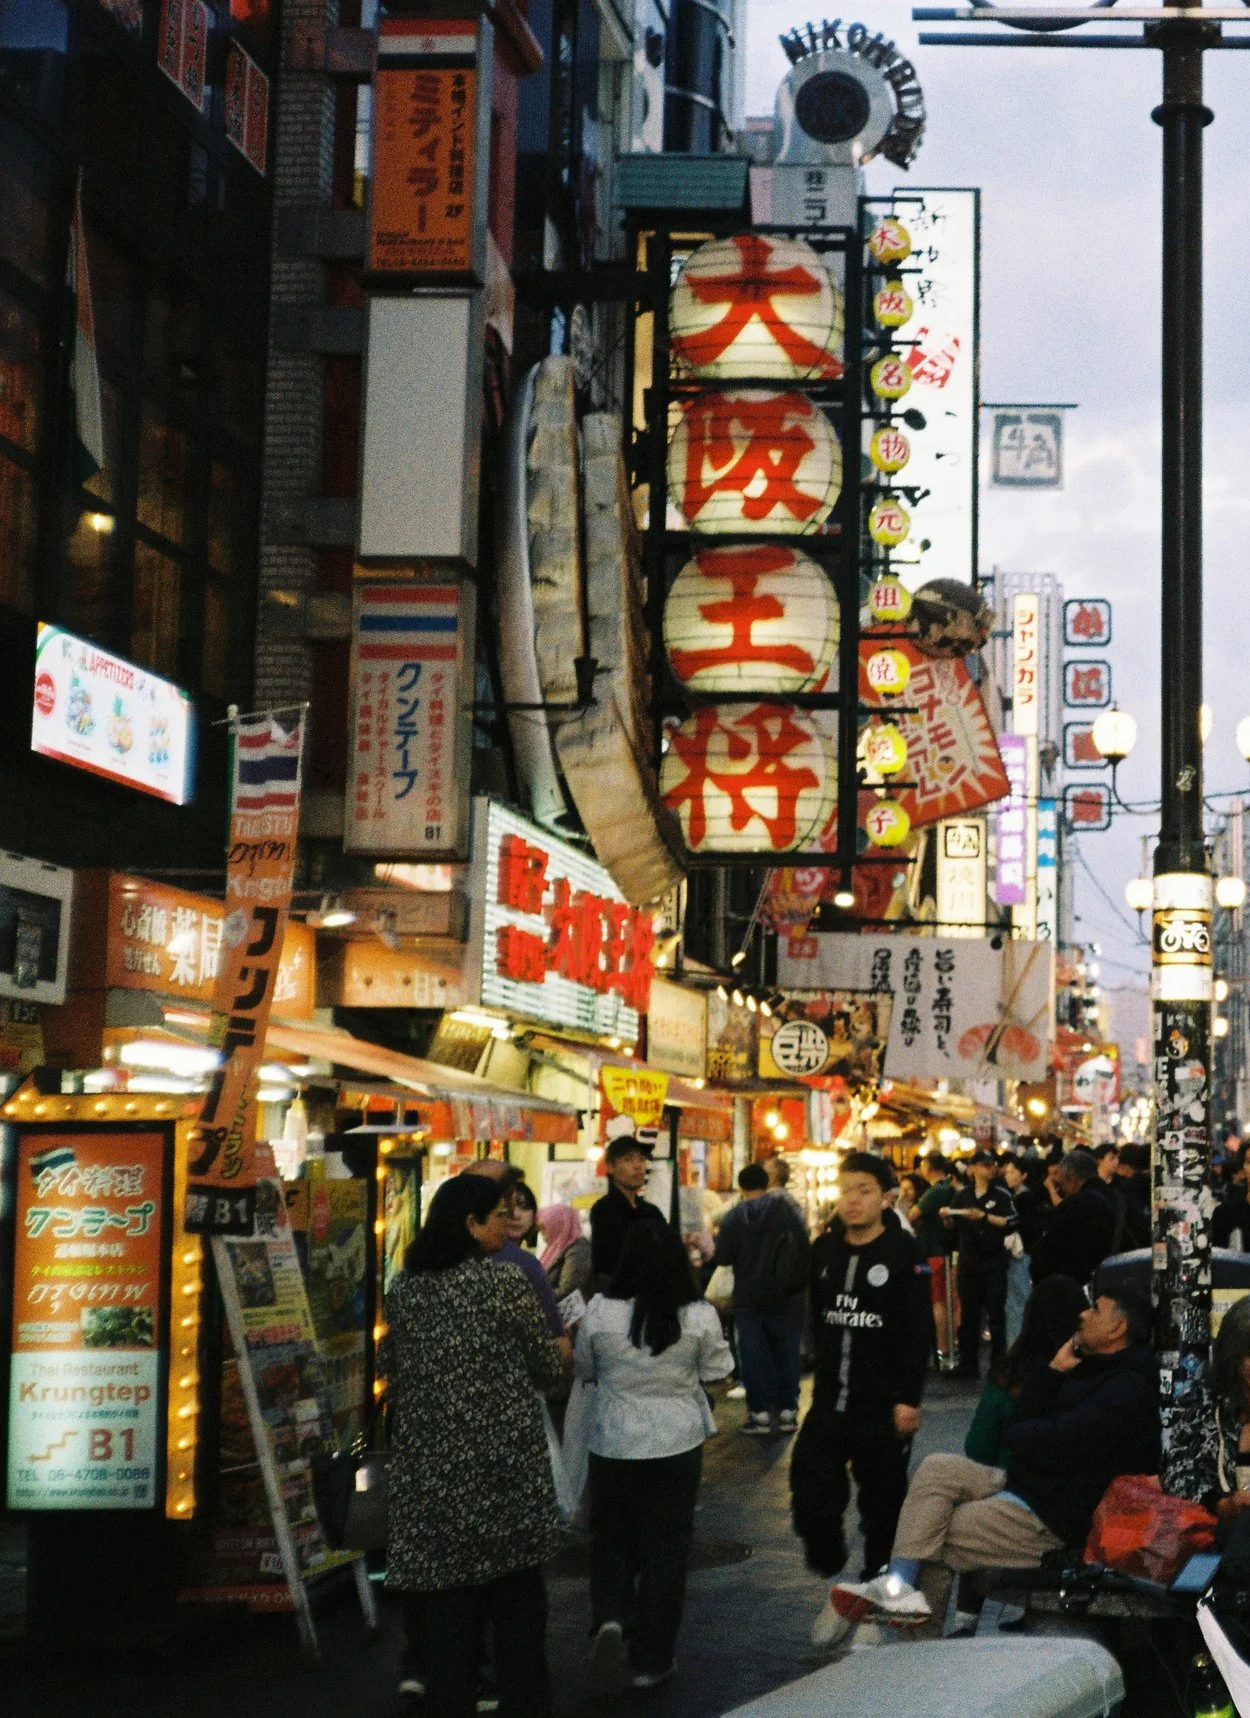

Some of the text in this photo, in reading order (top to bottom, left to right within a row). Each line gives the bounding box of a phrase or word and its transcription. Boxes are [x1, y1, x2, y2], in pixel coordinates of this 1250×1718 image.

[661, 234, 848, 850] 大阪王将
[36, 1163, 146, 1199] タイ料理
[214, 1198, 248, 1224] B1
[836, 1293, 858, 1310] Fly
[823, 1309, 884, 1329] mirates
[30, 1362, 140, 1377] Thai Restaurant
[18, 1381, 150, 1407] Krungtep
[88, 1427, 135, 1462] B1
[17, 1468, 40, 1481] TEL
